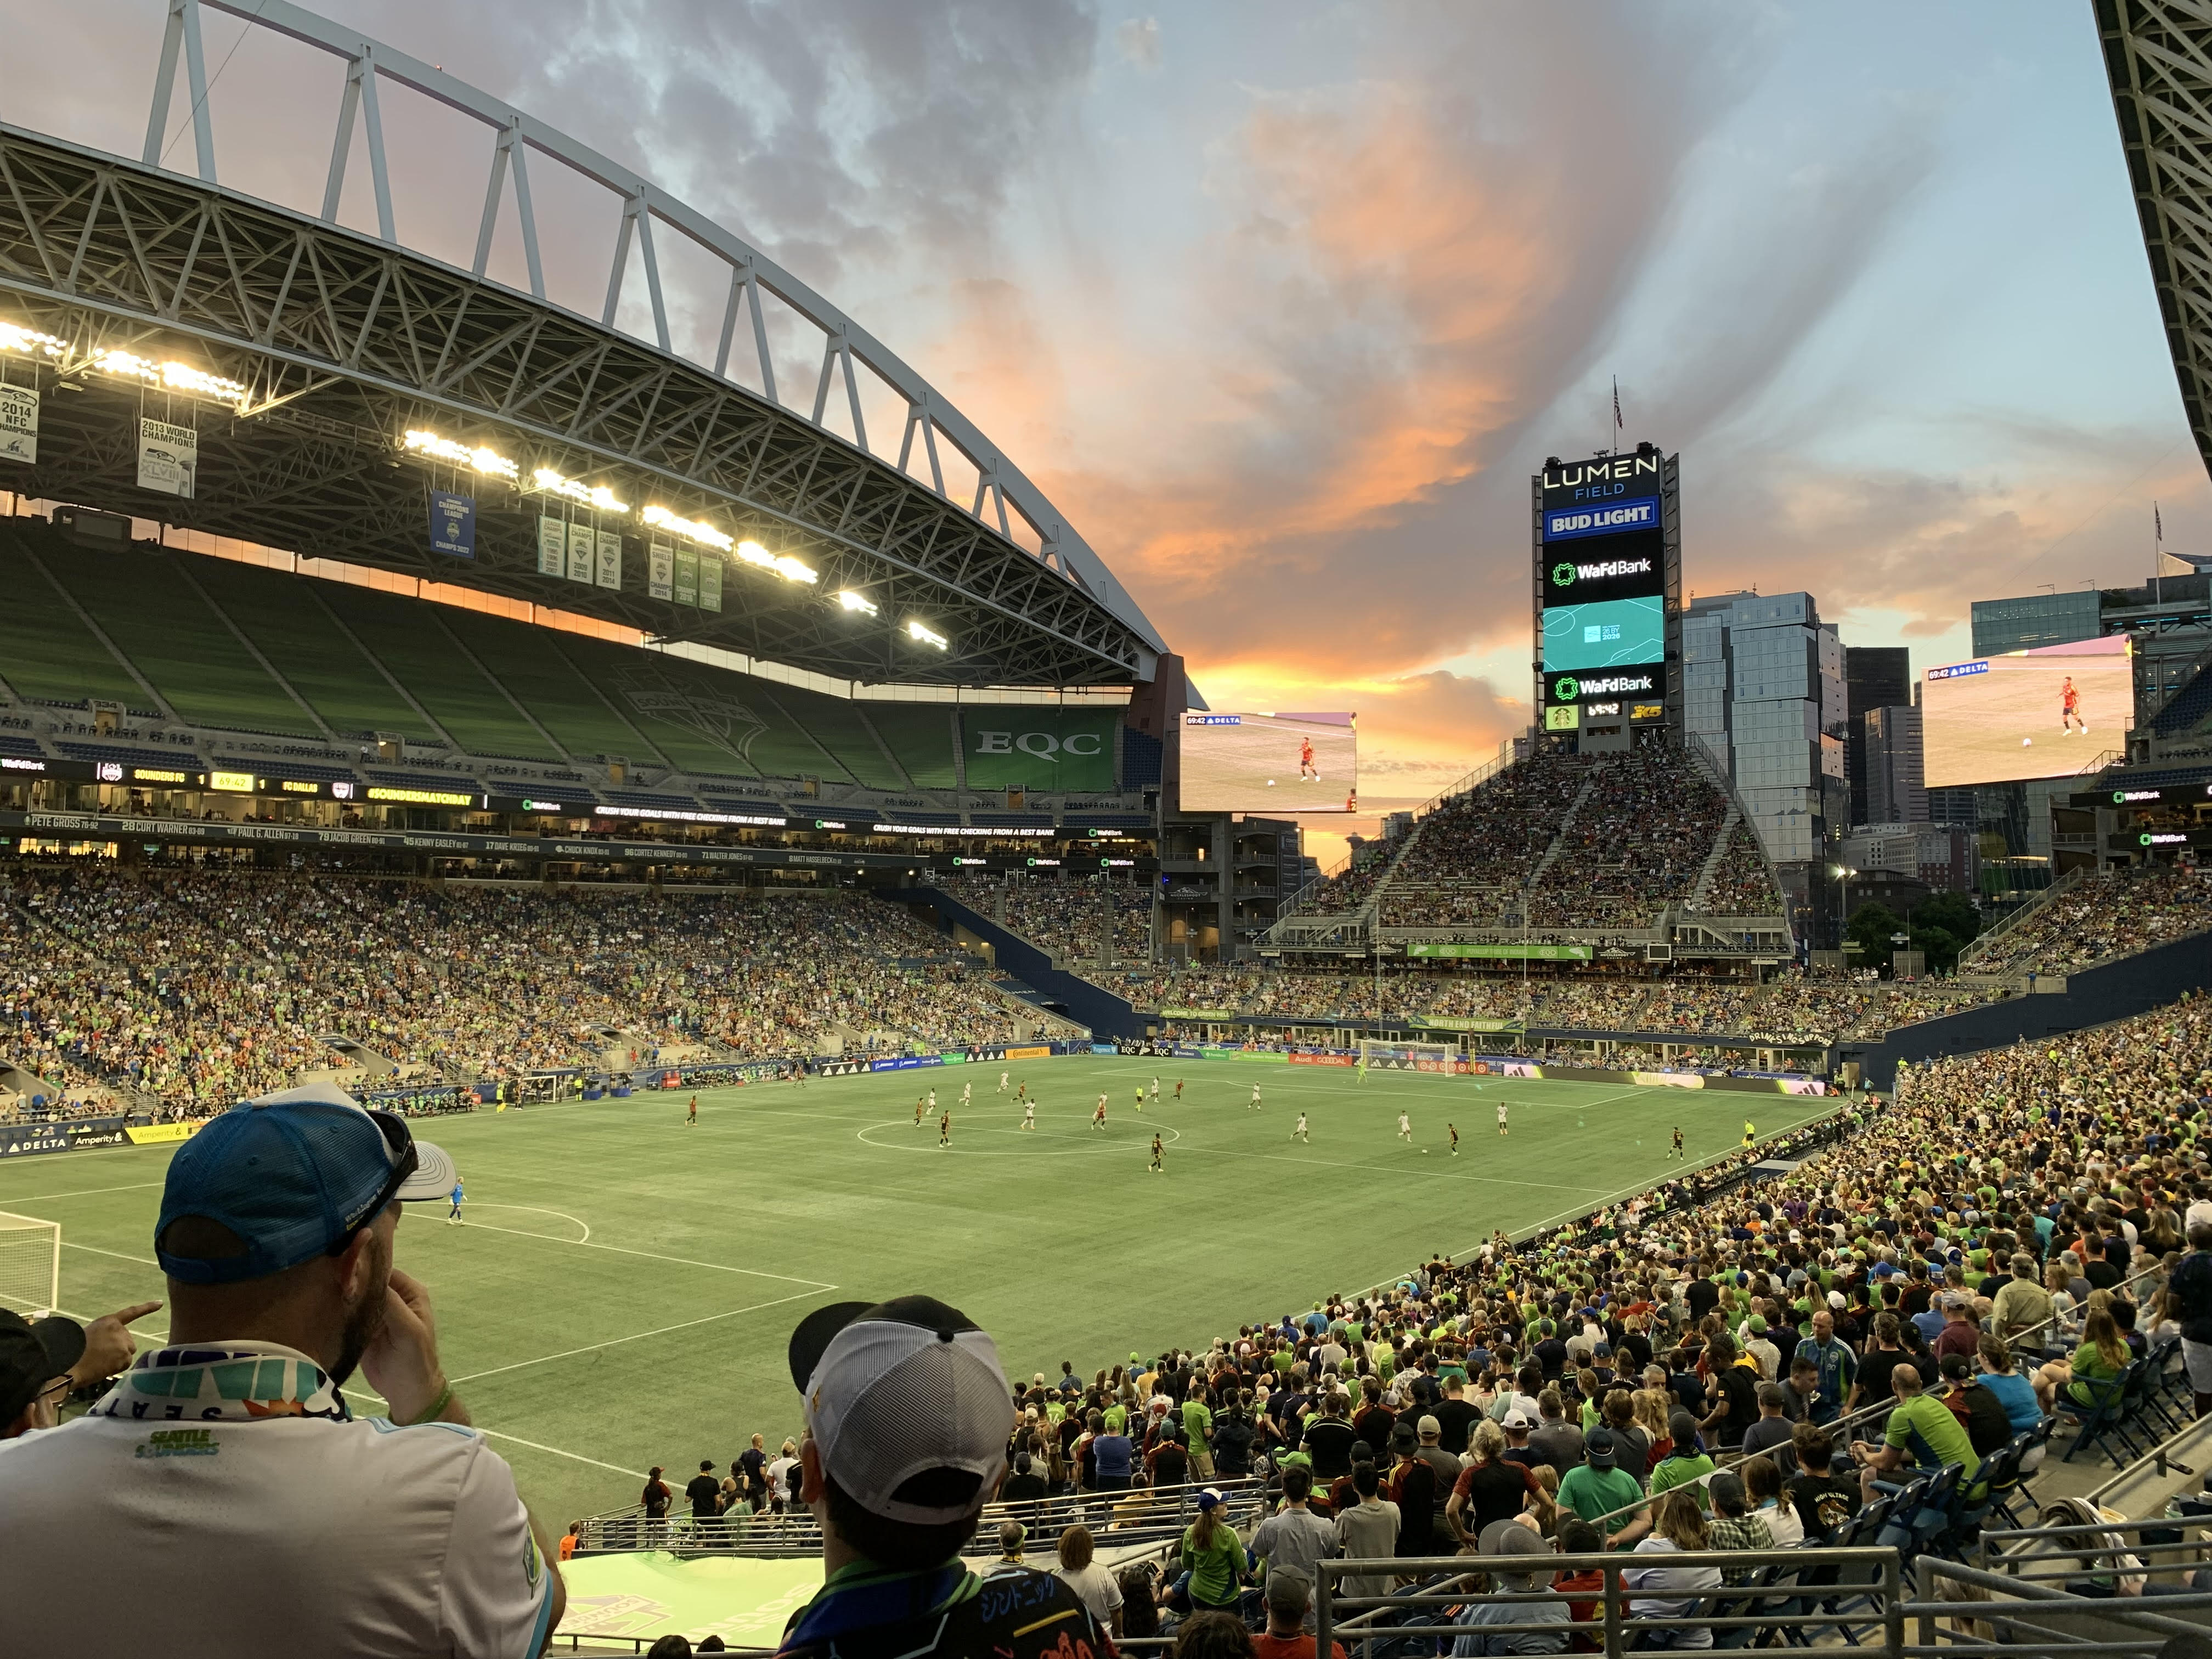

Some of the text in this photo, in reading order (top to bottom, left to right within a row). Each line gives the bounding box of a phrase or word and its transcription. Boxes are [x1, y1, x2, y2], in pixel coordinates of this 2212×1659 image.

[2, 402, 31, 418] 2014
[6, 414, 26, 427] NFC
[0, 423, 36, 437] HAMPIONS
[143, 421, 195, 440] 2013 WORLD
[142, 430, 194, 448] CHAMPIONS
[1544, 455, 1657, 489] LUMEN
[1575, 483, 1624, 500] FIELD
[1552, 506, 1650, 533] BUD LIGHT
[571, 531, 592, 540] CHAMPS
[599, 538, 619, 547] CHAMPS
[652, 551, 671, 561] SHIELD
[574, 562, 588, 571] 2009
[574, 570, 587, 578] 2010
[602, 568, 614, 577] 2011
[651, 581, 672, 591] CHAMPS
[654, 589, 667, 597] 2014
[1929, 662, 1988, 680] 69:42 DELTA
[1589, 703, 1618, 716] 69:42
[975, 731, 1102, 763] EQC
[134, 769, 174, 782] SOUNDERS
[175, 772, 185, 783] FC
[199, 774, 205, 785] 1
[219, 777, 246, 787] 69:42
[259, 779, 265, 789] 1
[283, 781, 318, 793] FC DALLAS
[368, 788, 472, 806] #SOUNDERSMATCHDAY
[595, 805, 619, 815] CRUSH
[620, 808, 639, 816] YOUR
[640, 809, 662, 818] GOALS
[663, 811, 680, 819] WITH
[680, 812, 696, 820] FREE
[697, 813, 727, 822] CHECKING
[728, 815, 747, 823] FROM
[32, 816, 51, 827] PETE
[53, 817, 80, 828] GROSS
[122, 821, 136, 831] 28
[136, 822, 156, 832] CURT
[157, 824, 188, 834] WARNER
[238, 828, 255, 838] PAUL
[264, 830, 284, 839] ALLEN
[319, 832, 329, 841] 79
[330, 833, 349, 843] JACOB
[351, 834, 371, 844] GREEN
[404, 837, 456, 848] 45 KENNY EASLEY
[495, 842, 509, 850] DAVE
[510, 843, 527, 851] KRIEG
[1429, 1019, 1503, 1030] NORTH END FAITHFUL
[1013, 1049, 1039, 1058] Continental
[1121, 1046, 1135, 1054] EQC
[1154, 1047, 1169, 1057] EQC
[75, 1135, 114, 1145] Amperity
[138, 1130, 174, 1139] Amperity
[23, 1139, 66, 1150] DELTA
[150, 1429, 211, 1444] SEATTLE
[1814, 1493, 1827, 1503] HIGH
